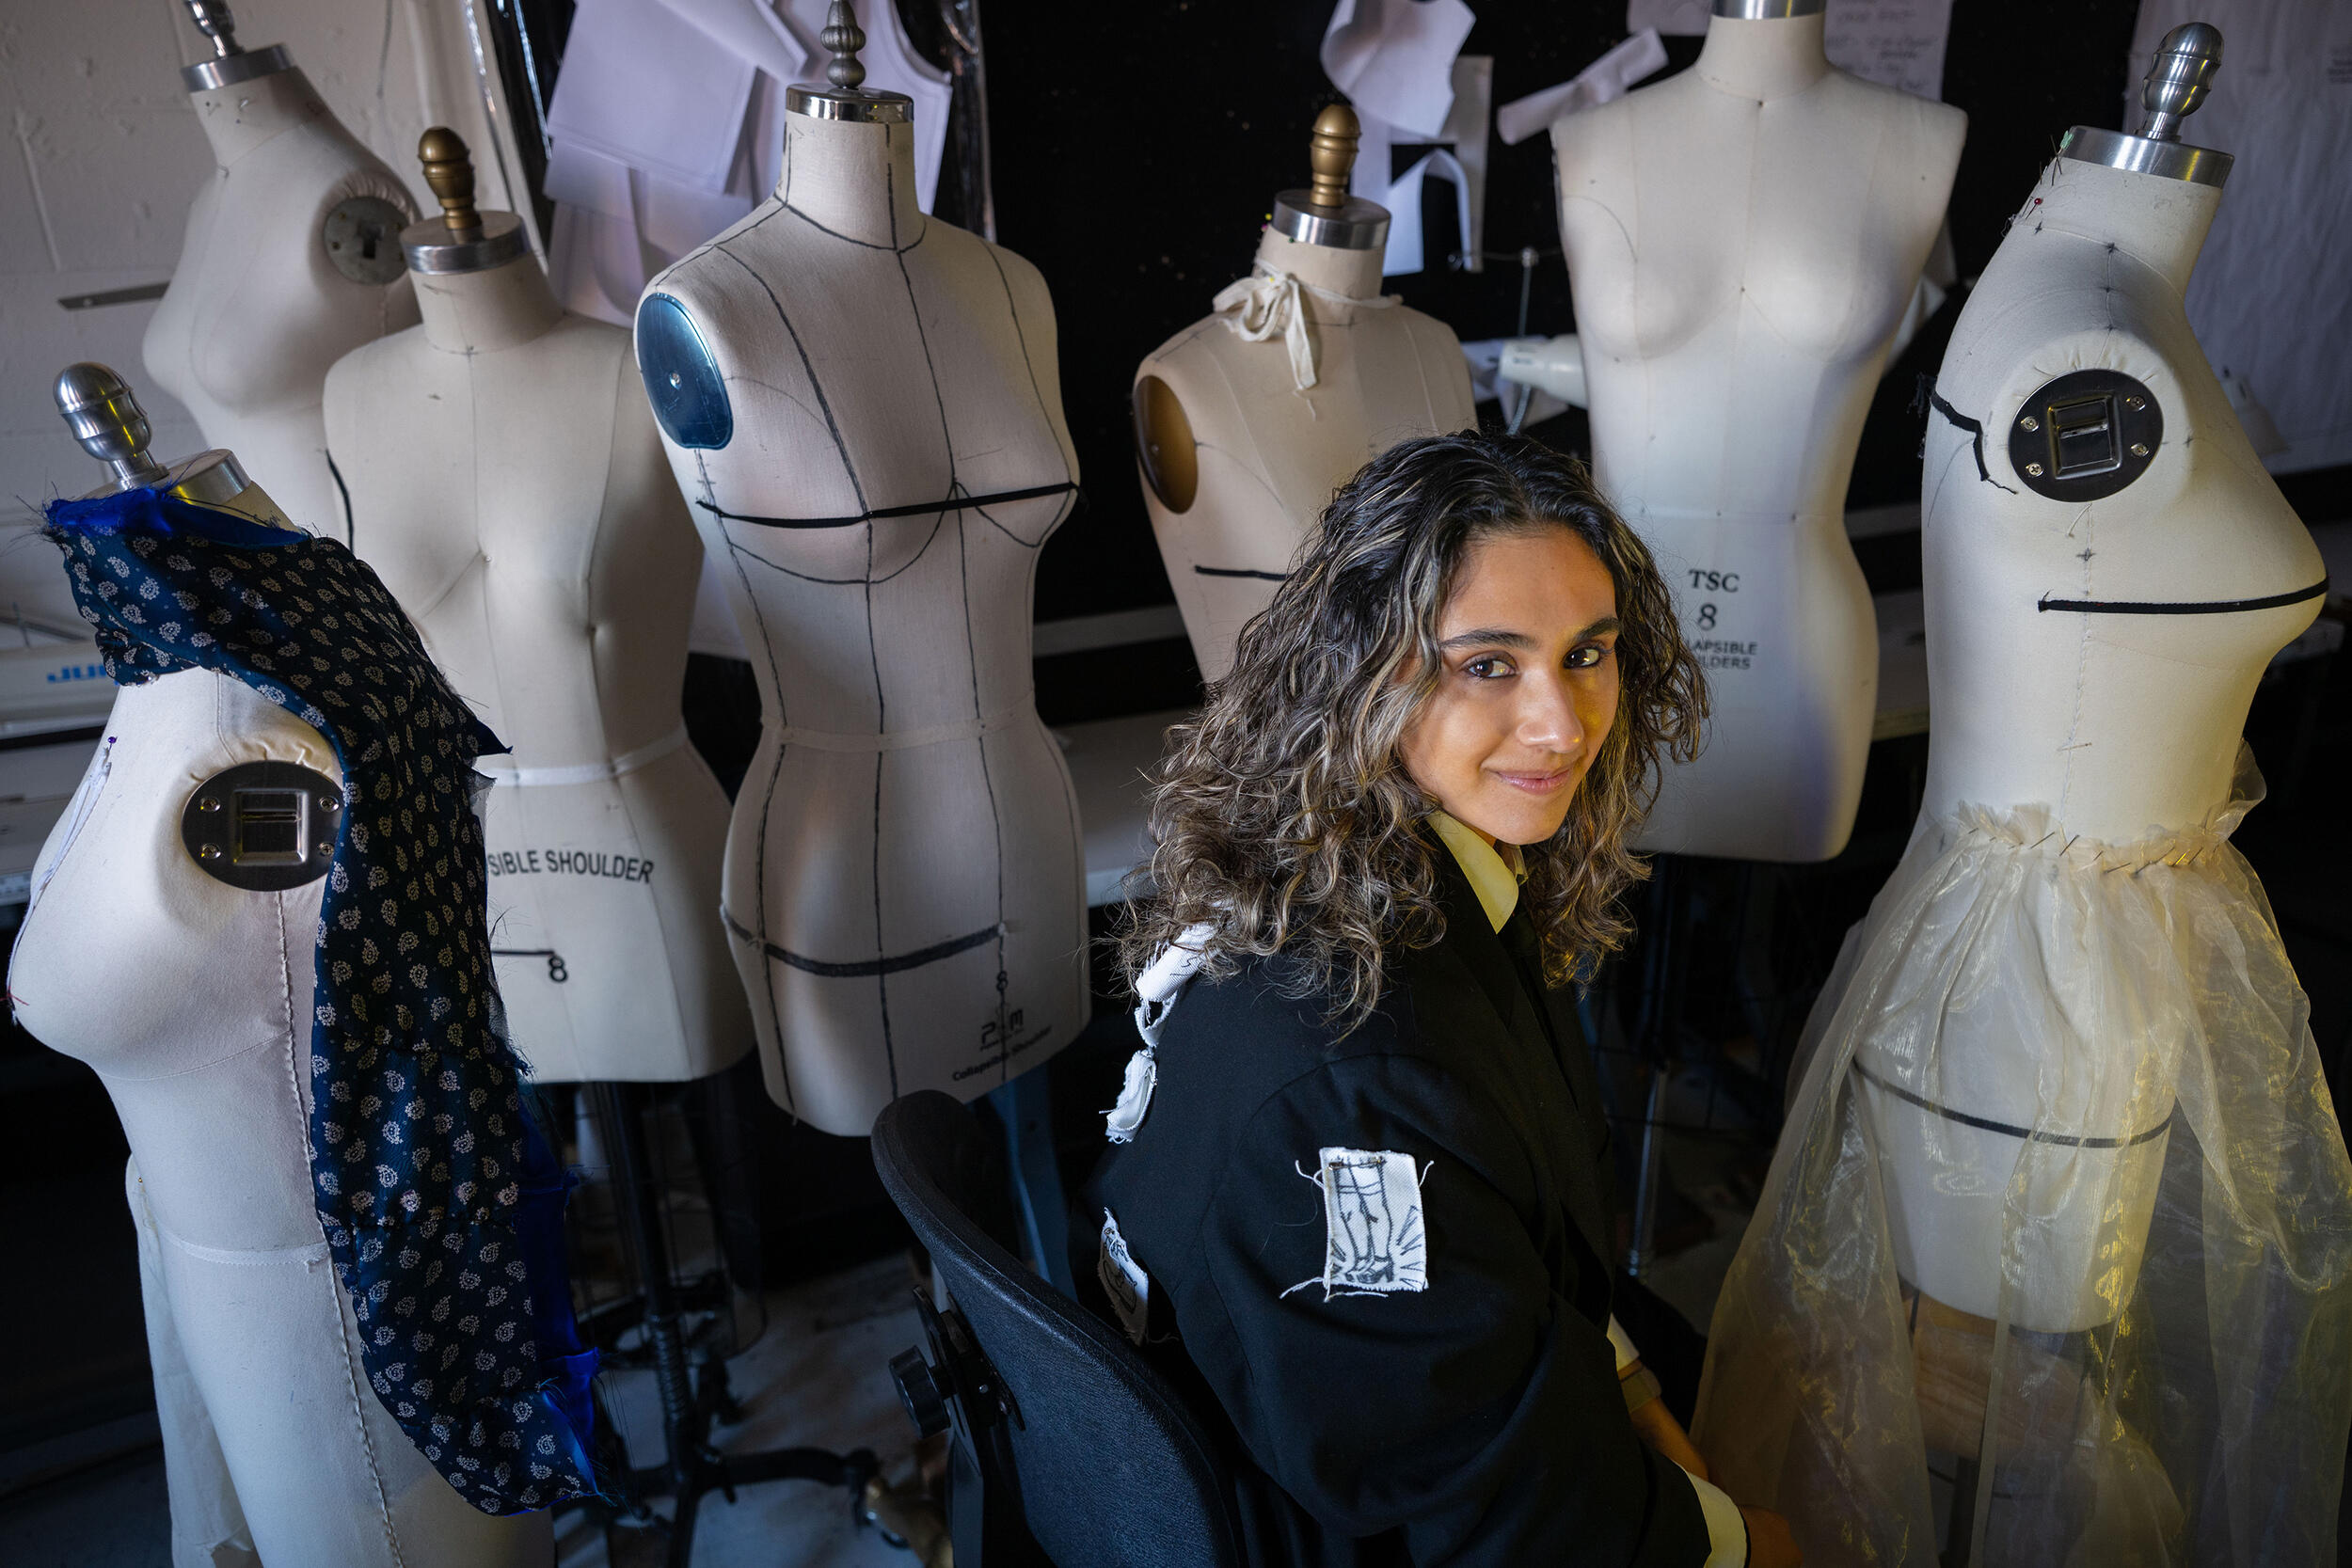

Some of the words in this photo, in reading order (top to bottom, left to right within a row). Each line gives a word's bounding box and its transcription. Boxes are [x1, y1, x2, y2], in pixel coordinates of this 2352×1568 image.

[1688, 568, 1740, 594] TSC
[1697, 603, 1718, 631] 8
[487, 849, 542, 877] SIBLE
[545, 849, 655, 884] SHOULDER
[548, 954, 568, 983] 8
[995, 971, 1009, 992] 8
